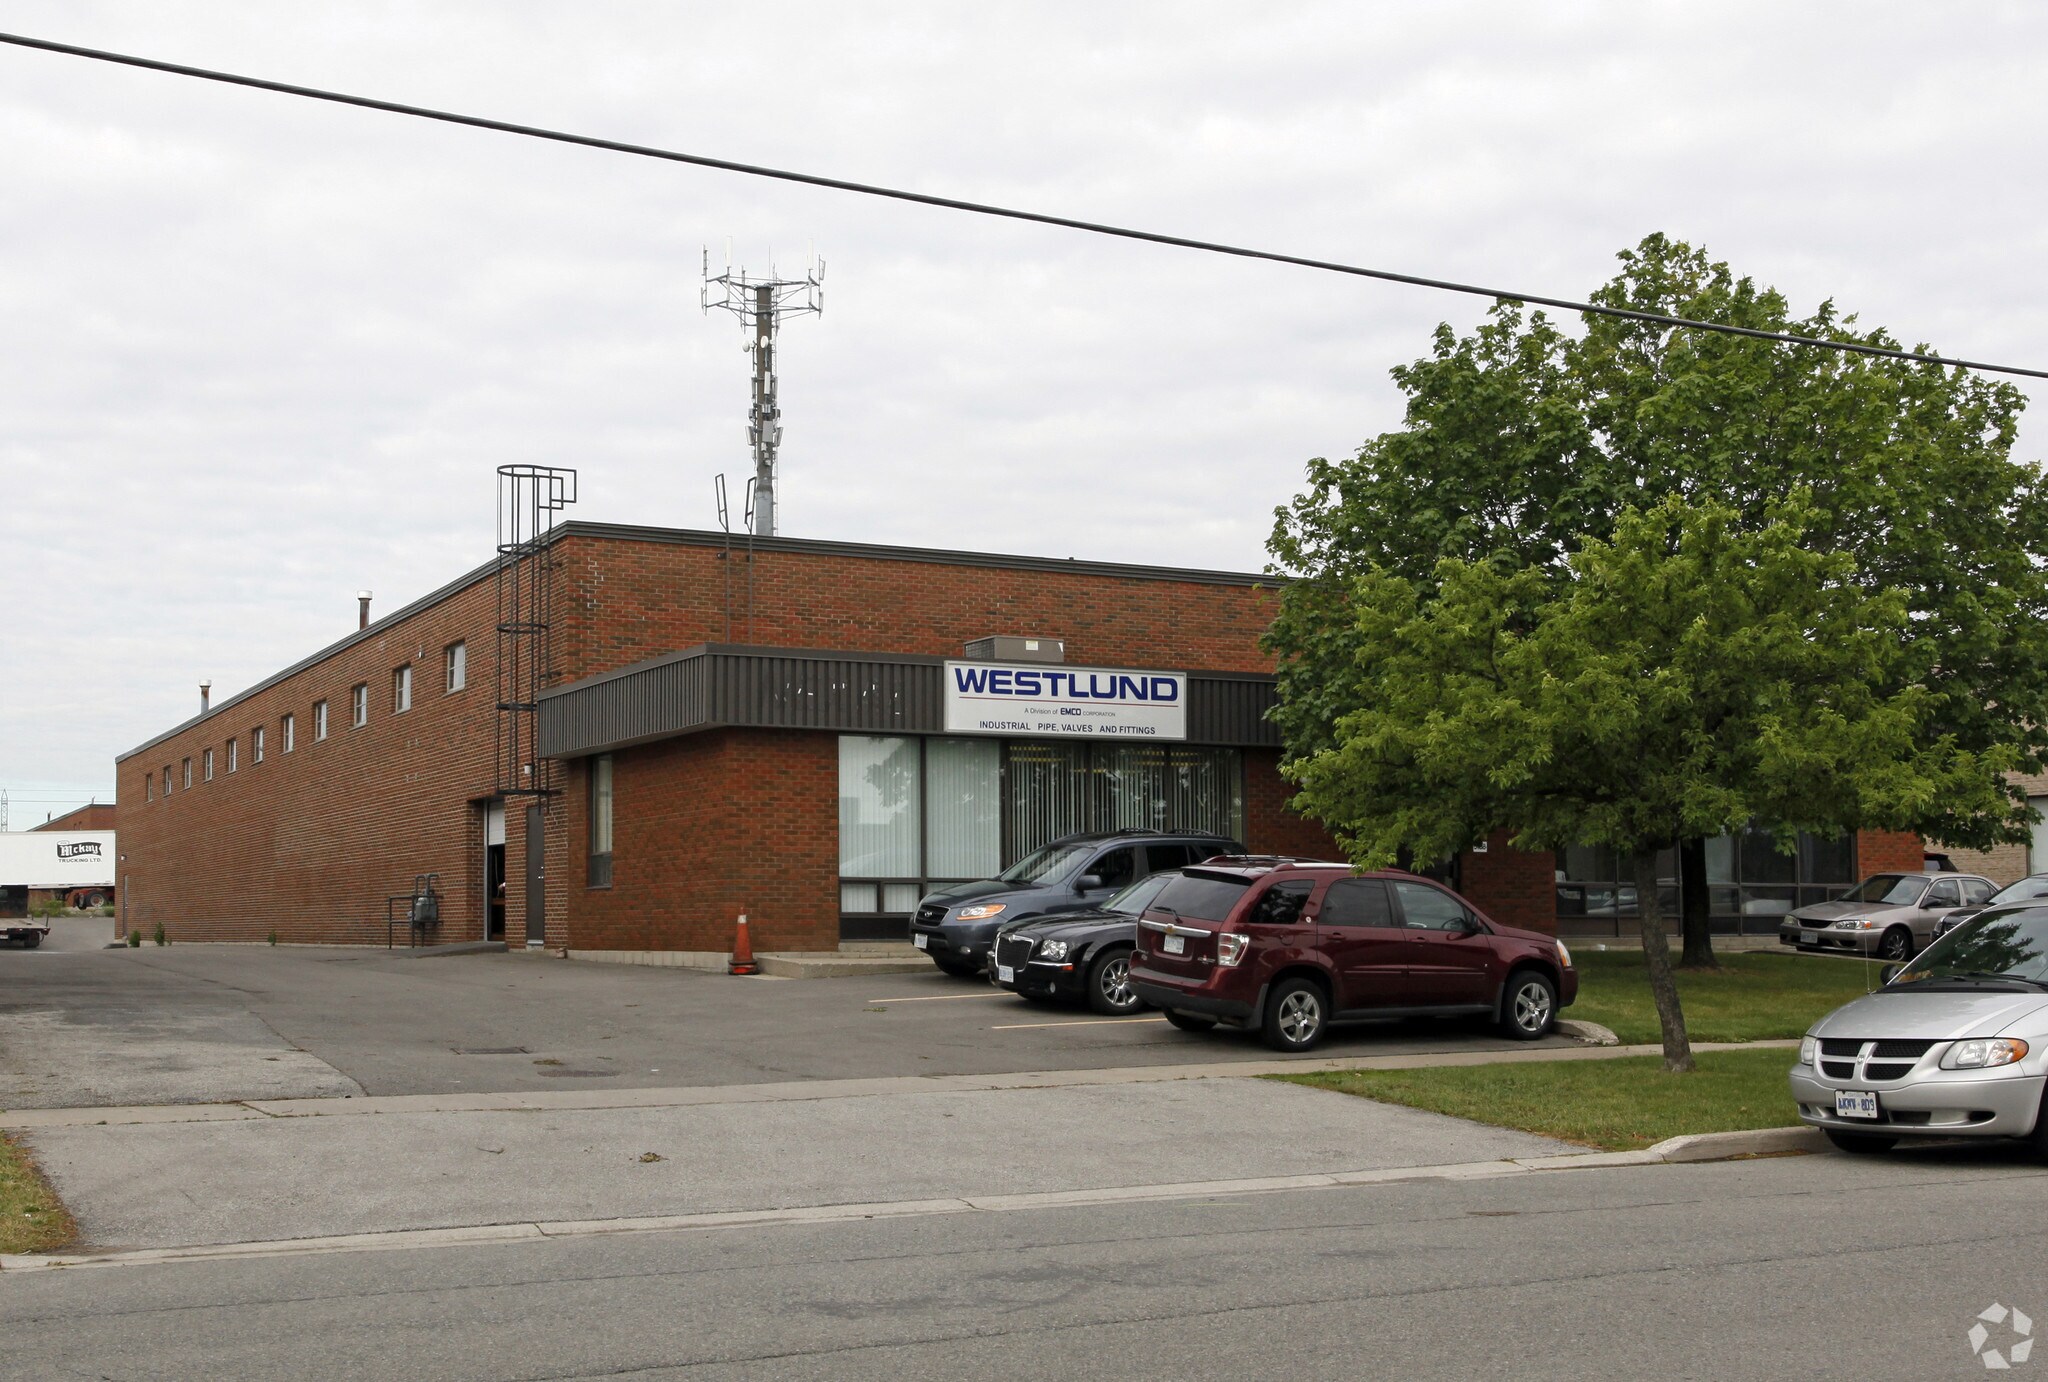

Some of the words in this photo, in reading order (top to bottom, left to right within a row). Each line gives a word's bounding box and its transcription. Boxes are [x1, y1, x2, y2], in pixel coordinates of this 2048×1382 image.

[954, 667, 1178, 701] WESTLUND
[1030, 707, 1051, 715] Division
[1060, 707, 1081, 716] EMCO
[979, 720, 1031, 731] INDUSTRIAL
[1037, 722, 1060, 733] PIPE,
[1061, 723, 1093, 733] VALVES
[1099, 725, 1117, 734] AND
[1119, 725, 1156, 735] FITTINGS
